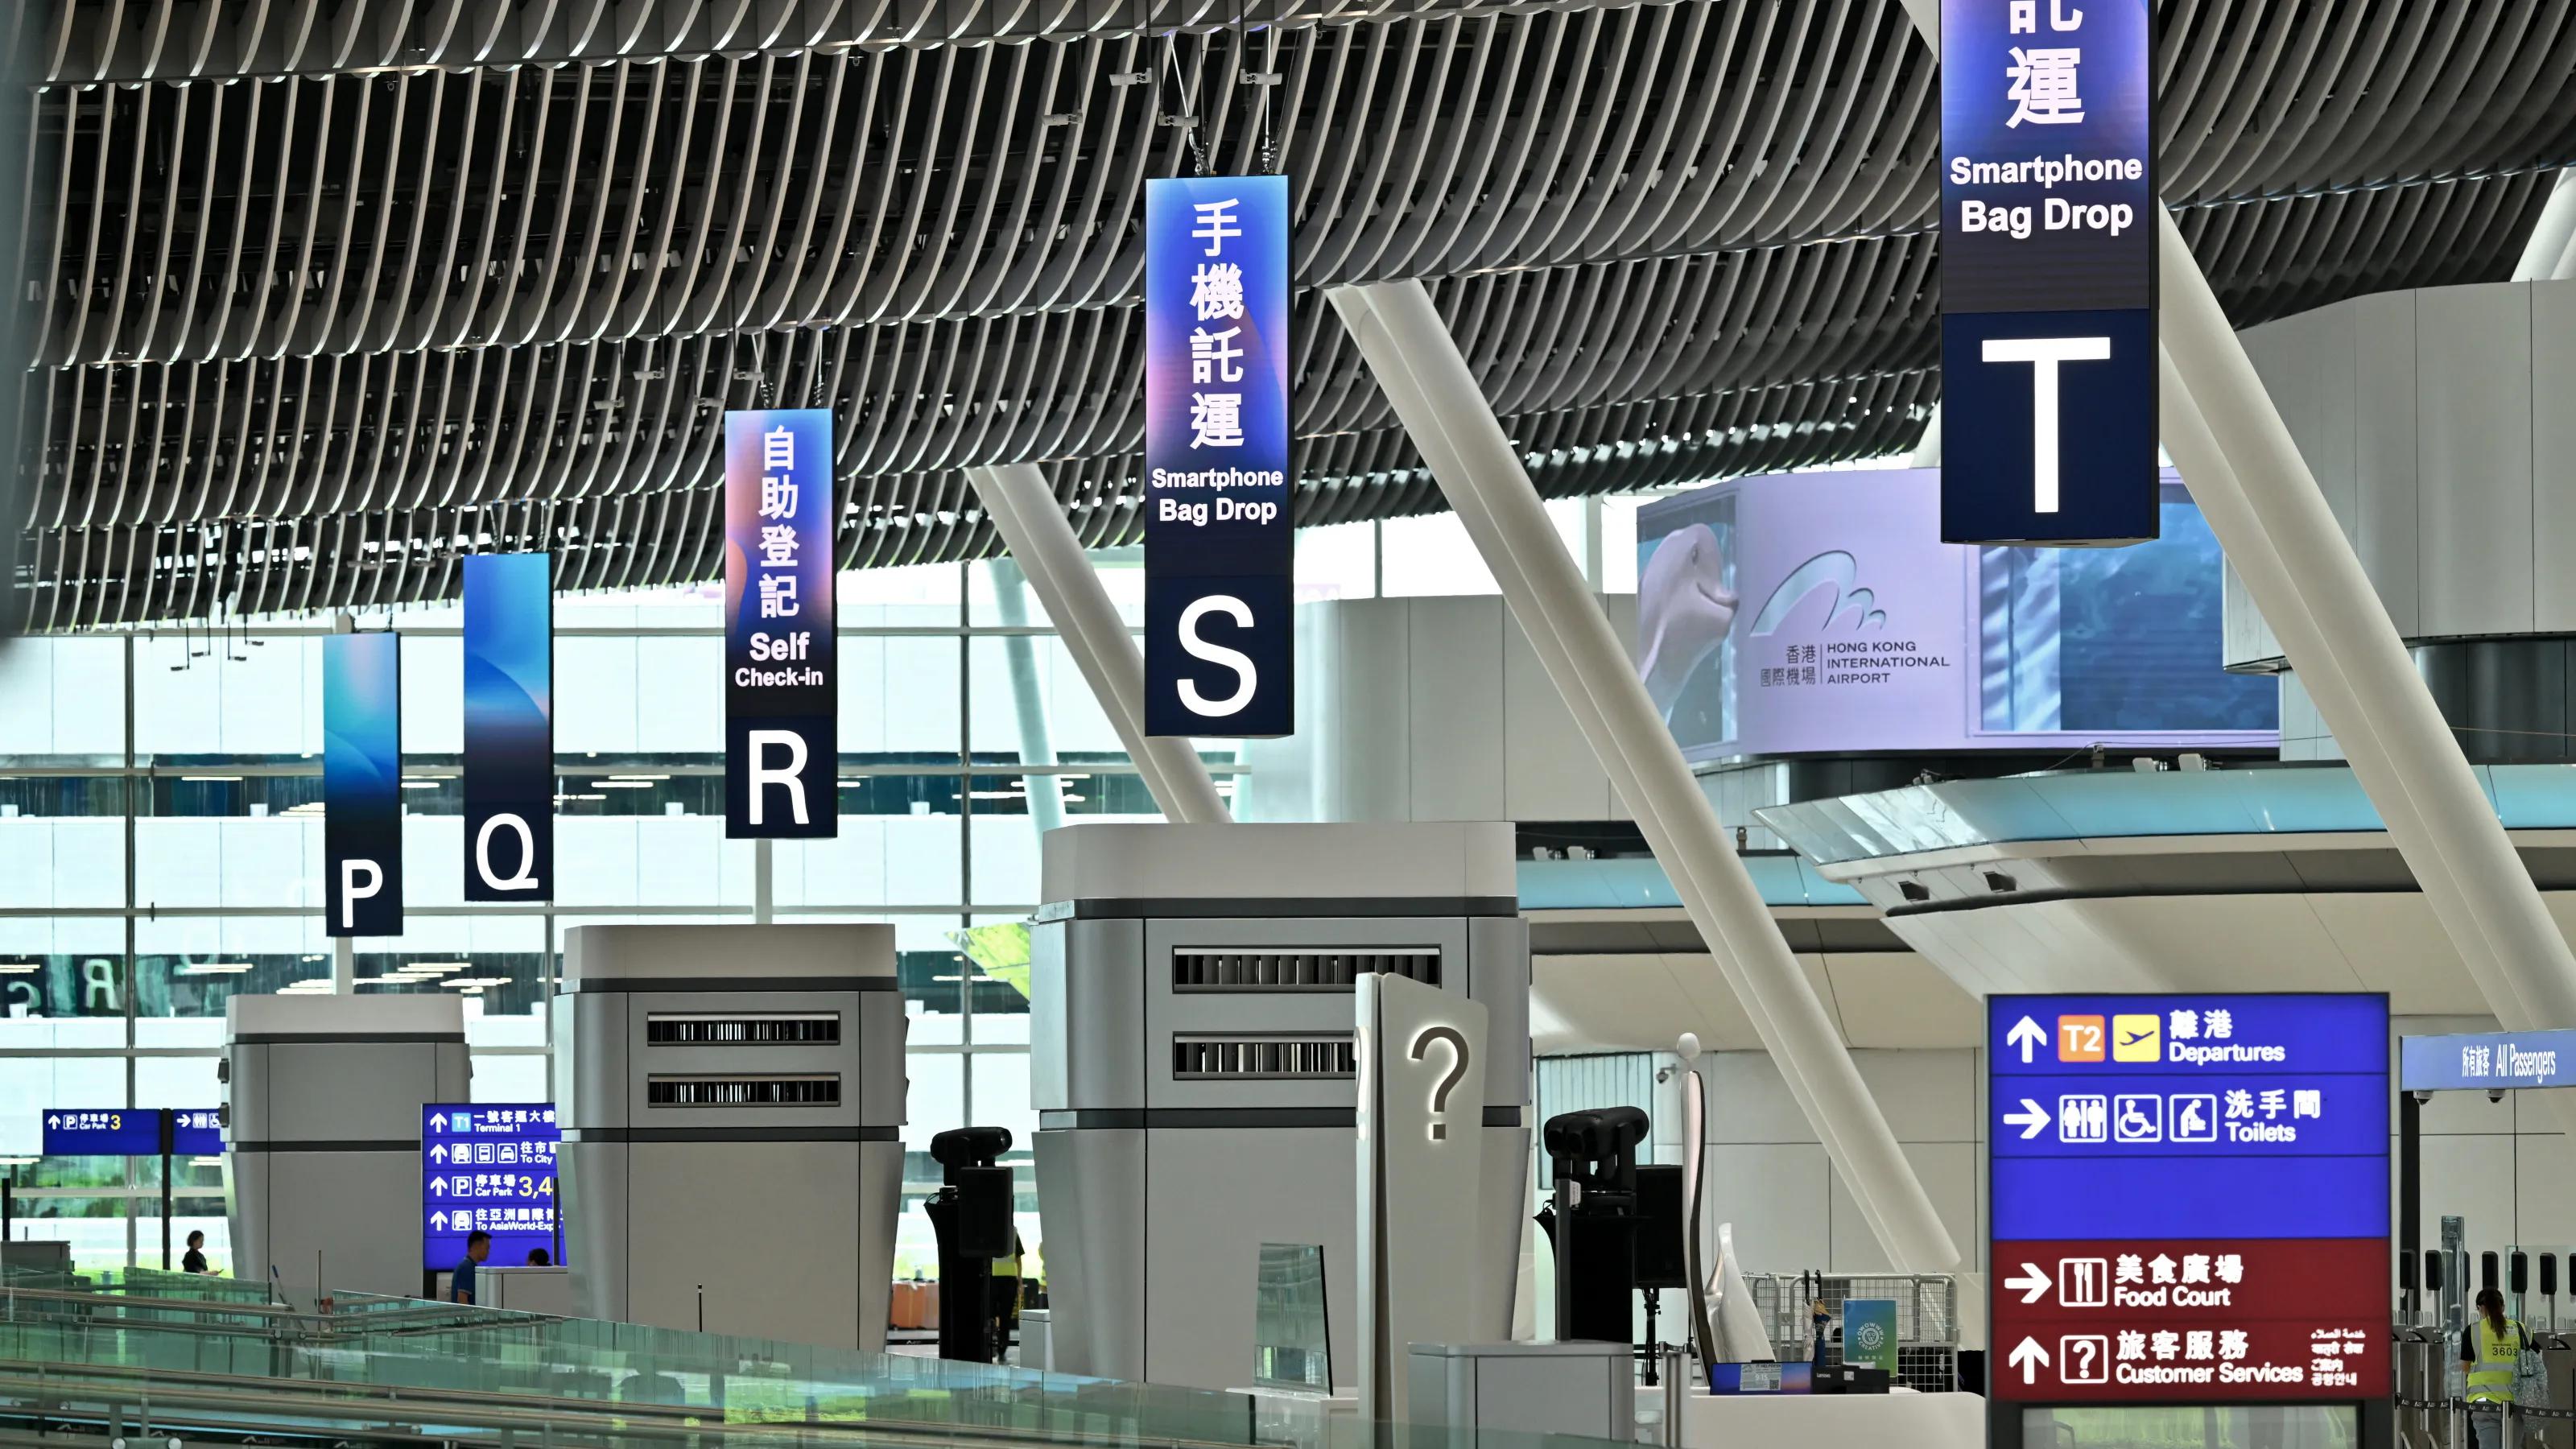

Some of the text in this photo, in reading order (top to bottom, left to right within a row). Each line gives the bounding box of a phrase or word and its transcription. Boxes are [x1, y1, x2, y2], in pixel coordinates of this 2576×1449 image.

[1950, 154, 2143, 188] Smartphone
[1961, 197, 2133, 239] Bag Drop
[1189, 197, 1245, 450] 手機託運
[1982, 336, 2111, 514] T
[1152, 467, 1284, 491] Smartphone
[758, 425, 799, 618] 自助登記
[1159, 497, 1278, 526] Bag Drop
[749, 631, 811, 662] Self
[1177, 594, 1257, 717] S
[1786, 645, 1816, 664] 香港
[1827, 641, 1917, 654] HONG KONG
[1827, 656, 1951, 669] INTERNATIONAL
[735, 667, 824, 687] Check-in
[1761, 667, 1816, 687] 國際機場
[1827, 673, 1891, 684] AIRPORT
[749, 729, 810, 825] R
[476, 812, 539, 891] Q
[341, 859, 383, 928] P
[2169, 1009, 2233, 1039] 離港
[2062, 1025, 2102, 1052] T2
[2169, 1041, 2286, 1067] Departures
[2462, 1045, 2490, 1078] 所有旅客
[2496, 1043, 2556, 1084] All Passengers
[2223, 1088, 2321, 1120] 洗手間
[110, 1114, 121, 1130] 3
[473, 1123, 521, 1133] Terminal 1
[2224, 1121, 2297, 1142] Toilets
[520, 1154, 553, 1166] To City
[475, 1187, 513, 1197] Car Park
[518, 1176, 553, 1199] 3,4
[475, 1221, 560, 1232] To AsiaWorld-Exp
[2114, 1253, 2244, 1284] 美食廣場
[2114, 1285, 2231, 1307] Food Court
[2116, 1329, 2249, 1361] 旅客服務
[2492, 1348, 2518, 1356] 3603
[2116, 1361, 2304, 1385] Customer Services
